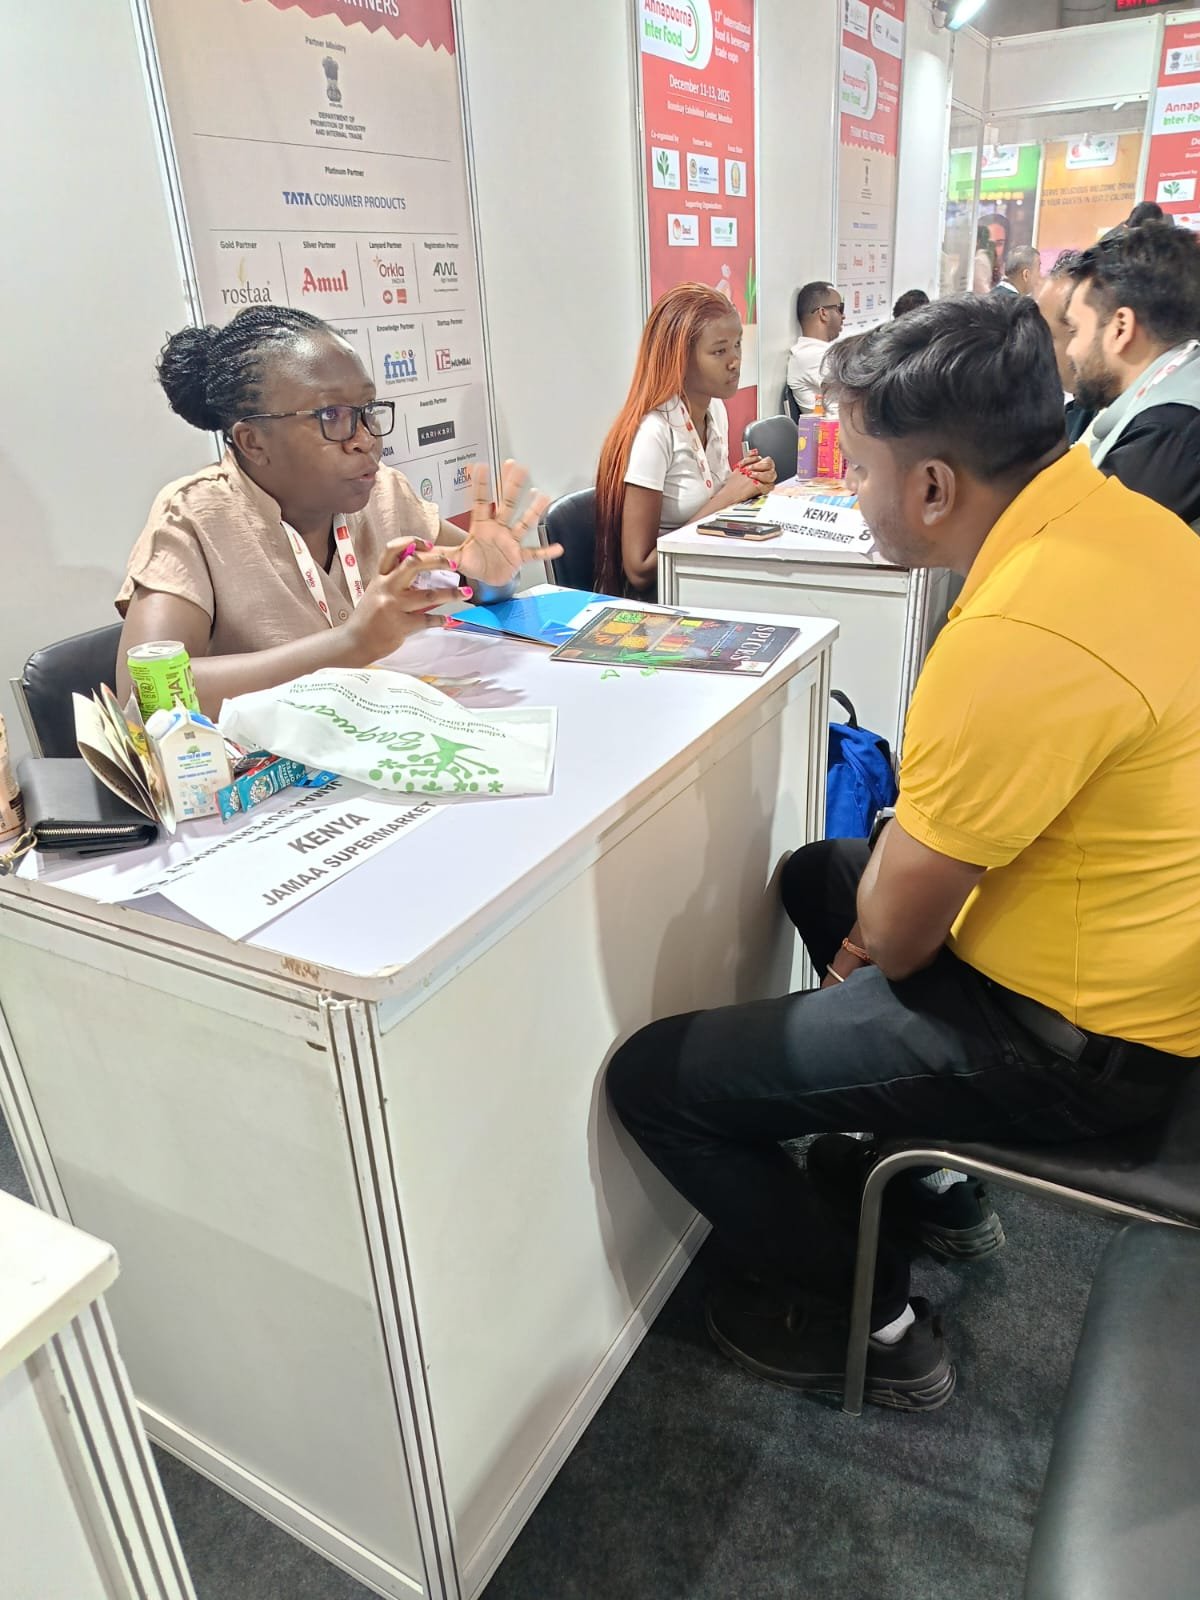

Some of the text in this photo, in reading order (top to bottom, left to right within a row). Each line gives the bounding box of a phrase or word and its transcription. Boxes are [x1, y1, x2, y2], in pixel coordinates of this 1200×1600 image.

[663, 25, 682, 47] Food
[669, 73, 699, 95] December
[1165, 101, 1200, 114] Annap
[282, 191, 406, 210] TATA CONSUMER PRODUCTS
[220, 241, 257, 249] Gold Partner
[302, 241, 336, 249] Silver Partner
[379, 262, 405, 277] Orkla
[221, 281, 272, 304] rostaa
[302, 267, 349, 296] Amul
[381, 446, 394, 457] NDIA
[803, 507, 838, 524] KENYA
[730, 626, 775, 661] SPICES
[290, 780, 343, 808] JAMAA
[287, 813, 370, 855] KENYA
[262, 801, 437, 906] JAMAA SUPERMARKET
